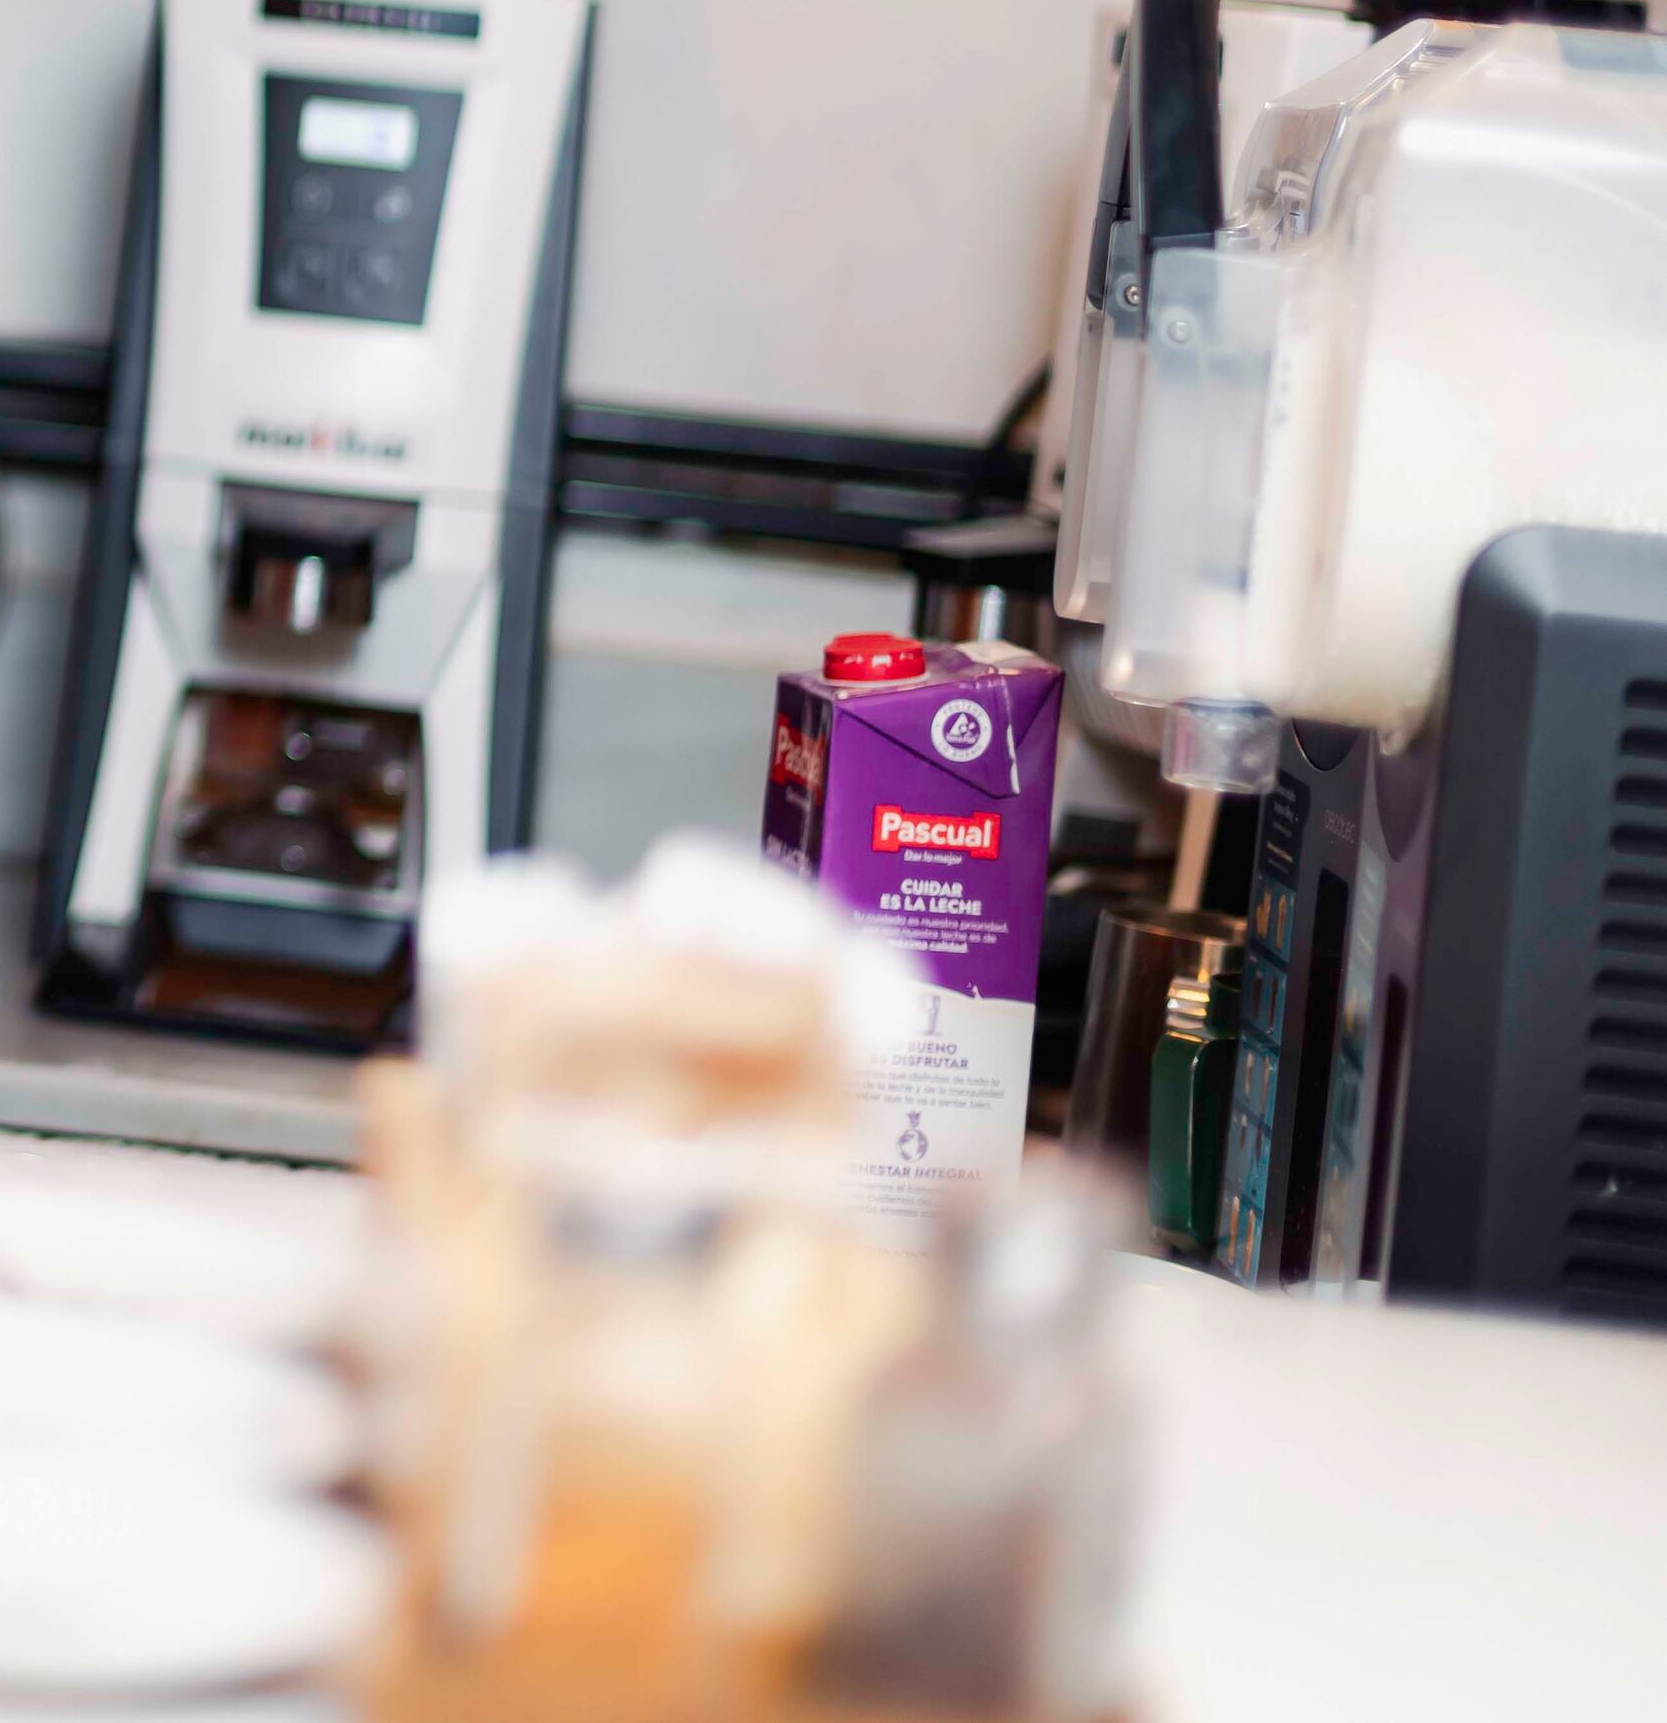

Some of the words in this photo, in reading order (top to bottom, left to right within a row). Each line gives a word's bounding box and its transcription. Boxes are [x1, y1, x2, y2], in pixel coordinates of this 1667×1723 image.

[880, 812, 992, 849] Pascual
[900, 878, 963, 897] CUIDAR
[880, 893, 902, 910] ES
[904, 896, 926, 912] LA
[929, 897, 983, 916] LECHE
[908, 1041, 958, 1055] BUENO
[892, 1054, 969, 1070] DISFRUTAR
